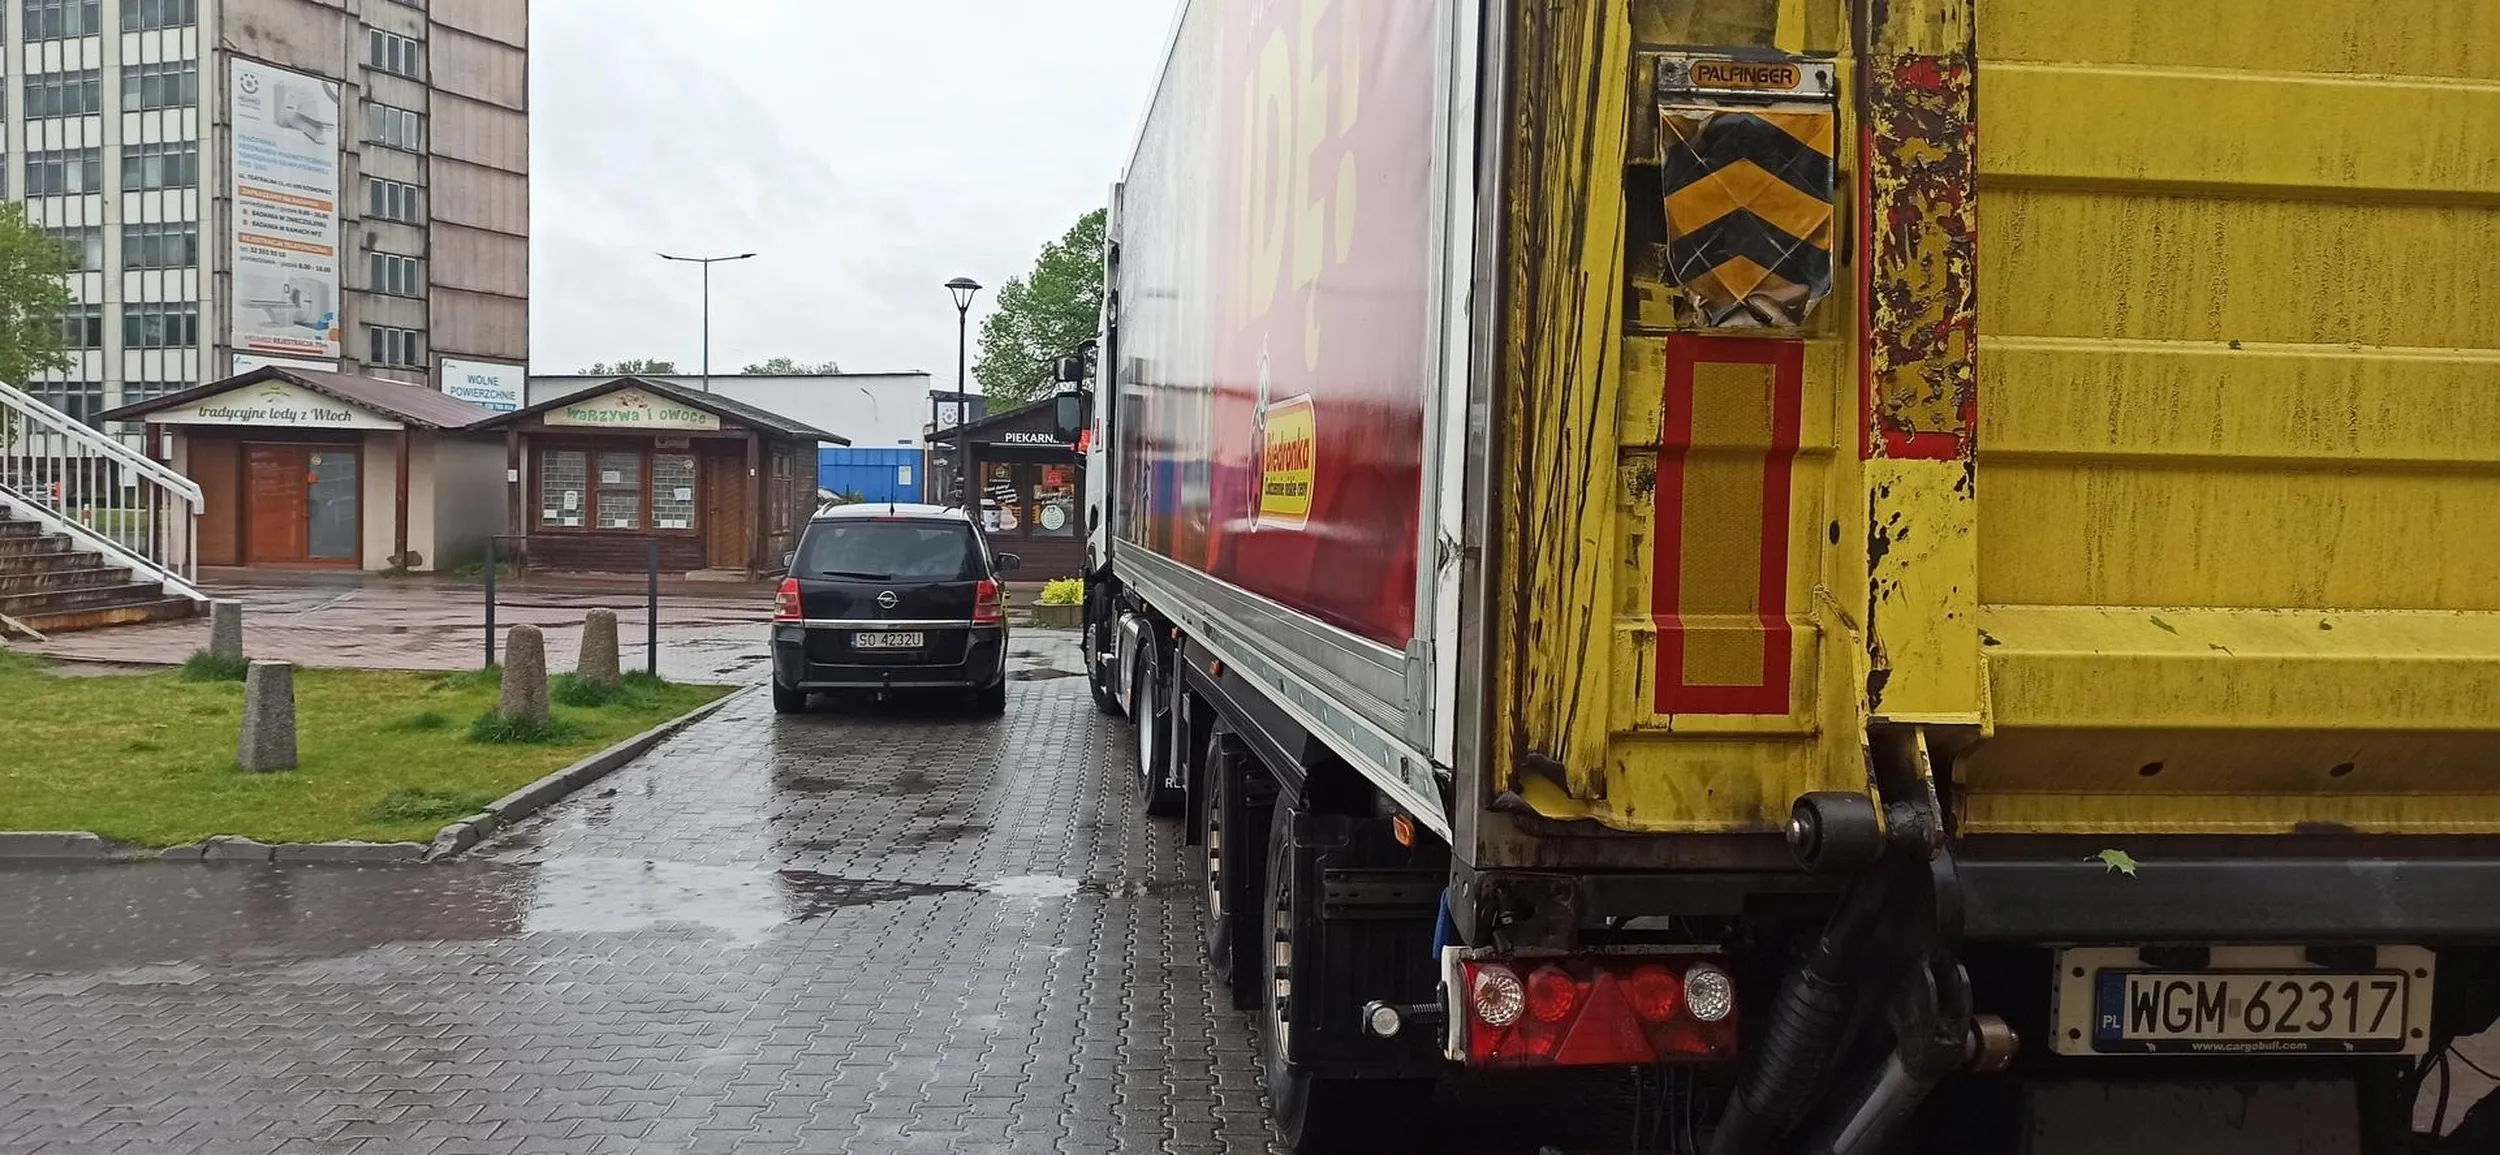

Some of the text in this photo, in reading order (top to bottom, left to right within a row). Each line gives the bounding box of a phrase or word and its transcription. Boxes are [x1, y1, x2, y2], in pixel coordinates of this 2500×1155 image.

[1698, 65, 1793, 85] PALFINGER
[467, 375, 499, 386] WOLNE
[450, 386, 516, 400] POWIERZCHNIE
[198, 406, 352, 423] tradycyjne lody z Włoch
[1005, 432, 1060, 443] PIEKARN
[859, 633, 876, 646] SO
[882, 634, 921, 646] 4232U
[2130, 980, 2398, 1034] WGM 62317
[2102, 1015, 2121, 1029] PL
[2191, 1041, 2308, 1053] www.cargobull.com
